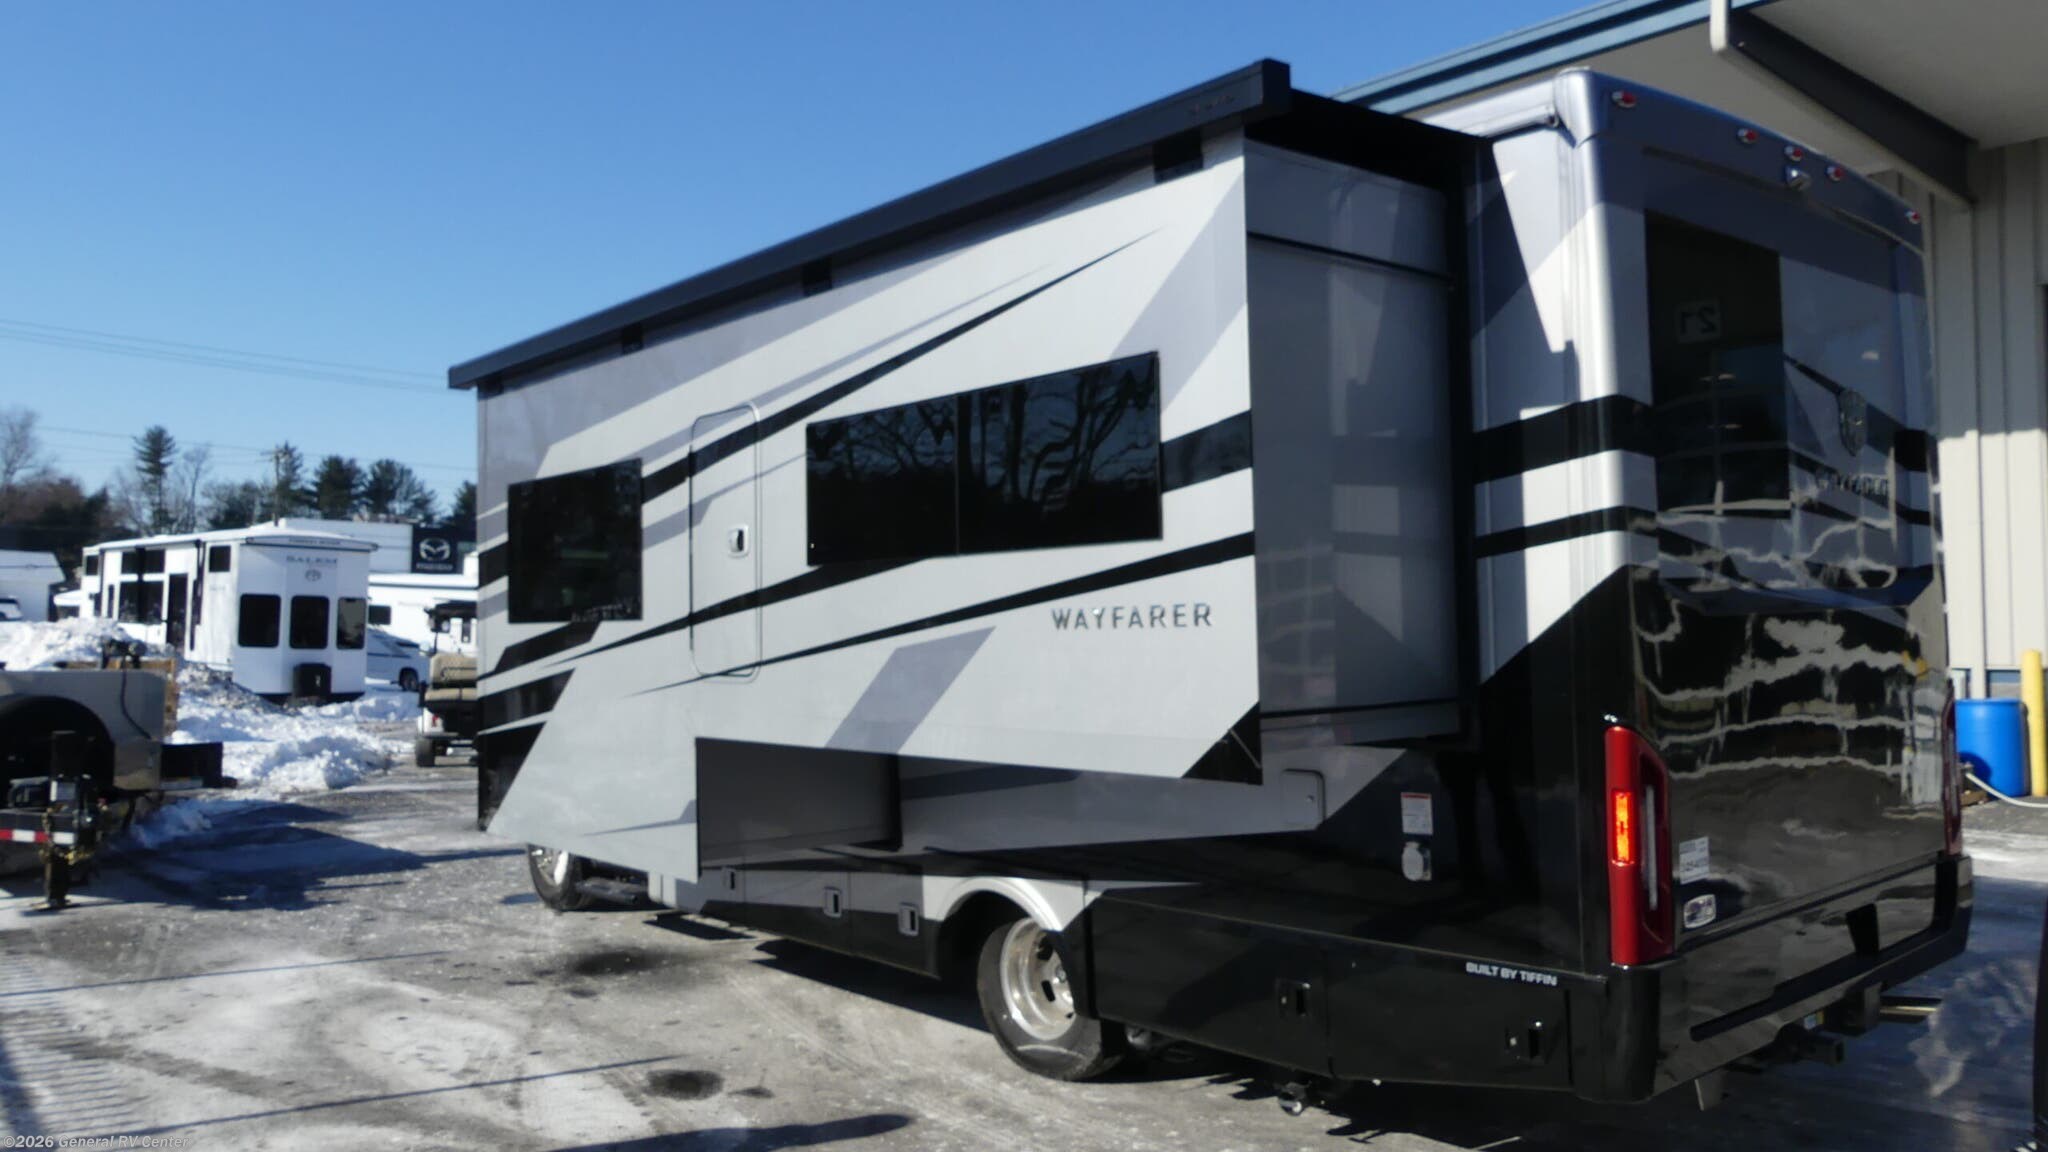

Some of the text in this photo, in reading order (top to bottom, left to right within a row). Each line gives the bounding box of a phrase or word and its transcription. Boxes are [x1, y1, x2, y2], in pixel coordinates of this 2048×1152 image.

[1051, 603, 1213, 630] WAYFARER
[1465, 961, 1558, 986] BUILT BY TIFFIN
